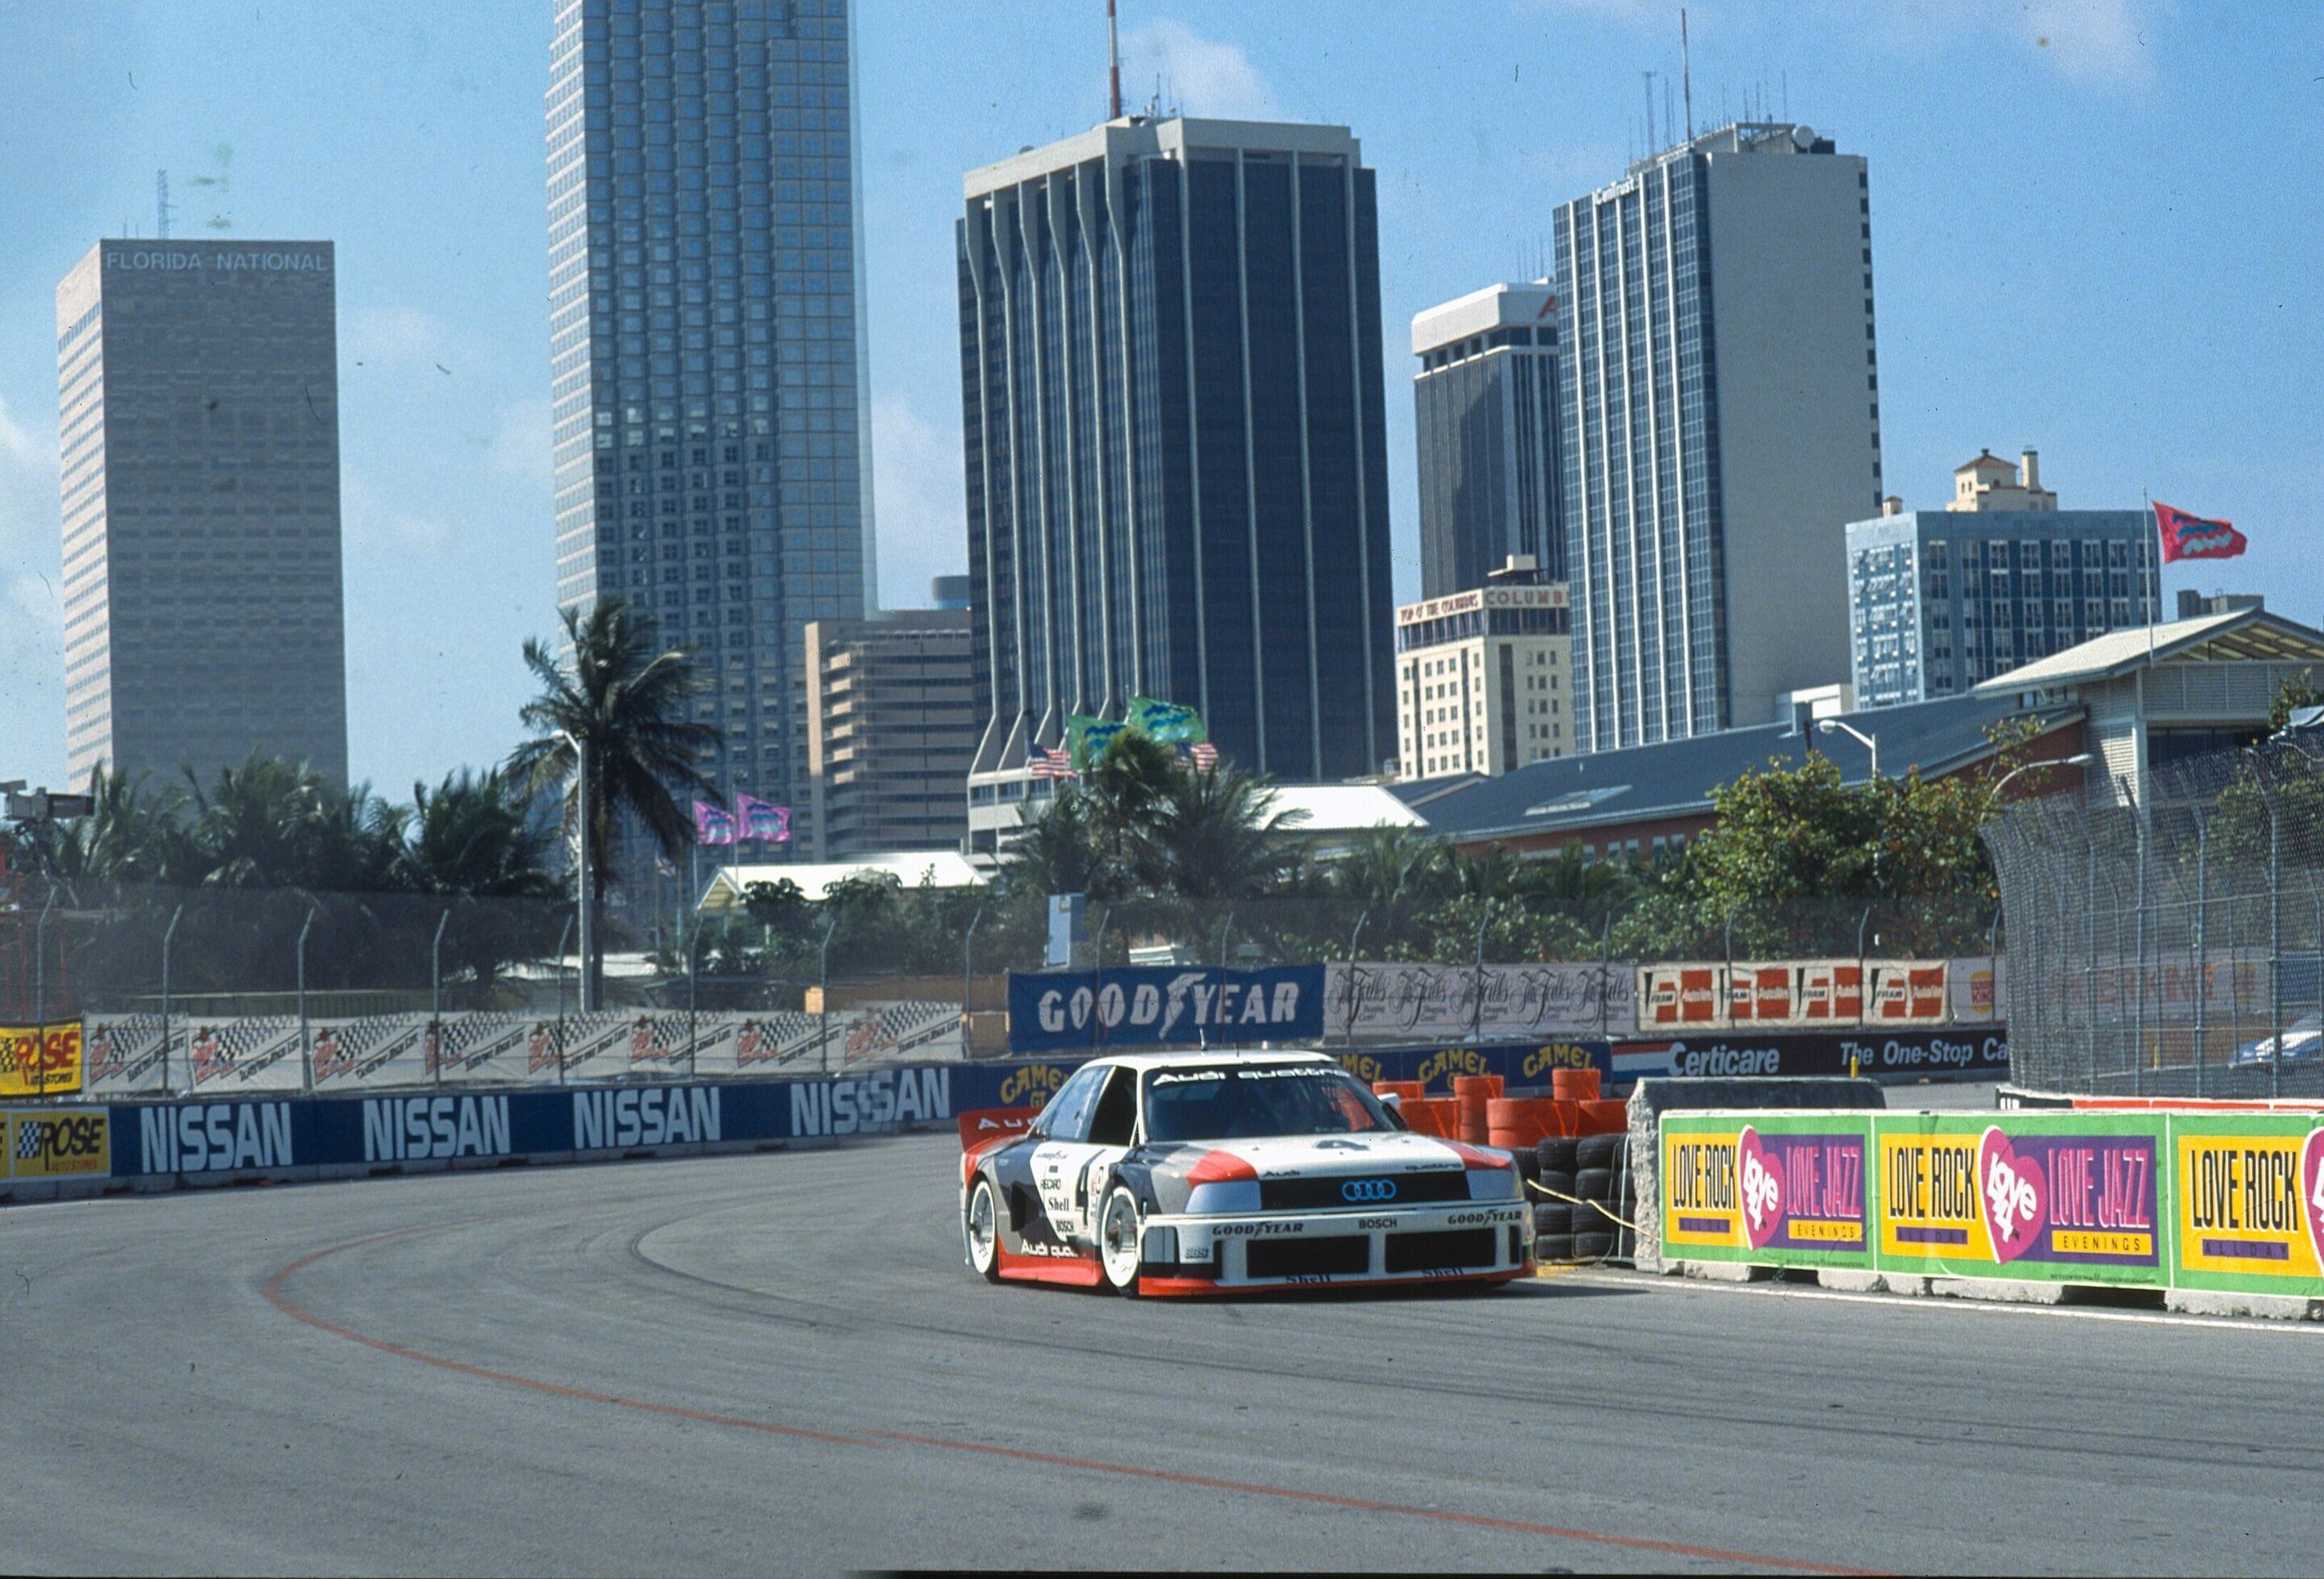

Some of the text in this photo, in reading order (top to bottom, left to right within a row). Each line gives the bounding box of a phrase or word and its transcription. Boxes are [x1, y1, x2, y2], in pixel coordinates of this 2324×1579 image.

[106, 251, 329, 273] FLORIDA NATIONAL
[1485, 591, 1570, 605] COLUMB
[1651, 993, 1674, 1004] FRAM
[1802, 989, 1826, 999] FRAM
[1876, 989, 1903, 999] FRAM
[1038, 973, 1299, 1041] GOODYEAR
[16, 1031, 79, 1085] ROSE
[1523, 1044, 1595, 1079] CAMEL
[1668, 1042, 1780, 1077] Certicare
[1841, 1042, 1875, 1067] The
[1883, 1037, 1975, 1070] One-Stop
[1153, 1067, 1352, 1087] Audi quattro
[1418, 1050, 1492, 1084] CAMEL
[1001, 1064, 1069, 1105] CAME
[792, 1067, 951, 1136] NISSAN
[364, 1096, 511, 1162] NISSAN
[573, 1087, 721, 1150] NISSAN
[40, 1117, 104, 1171] ROSE
[140, 1103, 293, 1174] NISSAN
[1261, 1162, 1463, 1177] Audi quattro
[1672, 1144, 1737, 1210] LOVE ROCK
[1040, 1178, 1062, 1191] RECARO
[1786, 1146, 1862, 1218] LOVE JAZZ
[1888, 1147, 1976, 1222] LOVE ROCK
[2048, 1148, 2151, 1229] LOVE JAZZ
[2190, 1149, 2239, 1230] LOVE
[2243, 1149, 2299, 1232] ROCK
[1048, 1197, 1070, 1212] Shell
[1055, 1219, 1076, 1233] BOSCH
[1359, 1218, 1398, 1229] BOSCH
[1448, 1209, 1523, 1226] GOODYEAR
[1212, 1222, 1305, 1237] GOODYEAR
[1798, 1224, 1855, 1238] EVENINGS
[1021, 1239, 1049, 1256] Audi
[2063, 1235, 2141, 1251] EVENINGS
[1285, 1274, 1332, 1285] Shell
[1422, 1267, 1465, 1278] Shell
